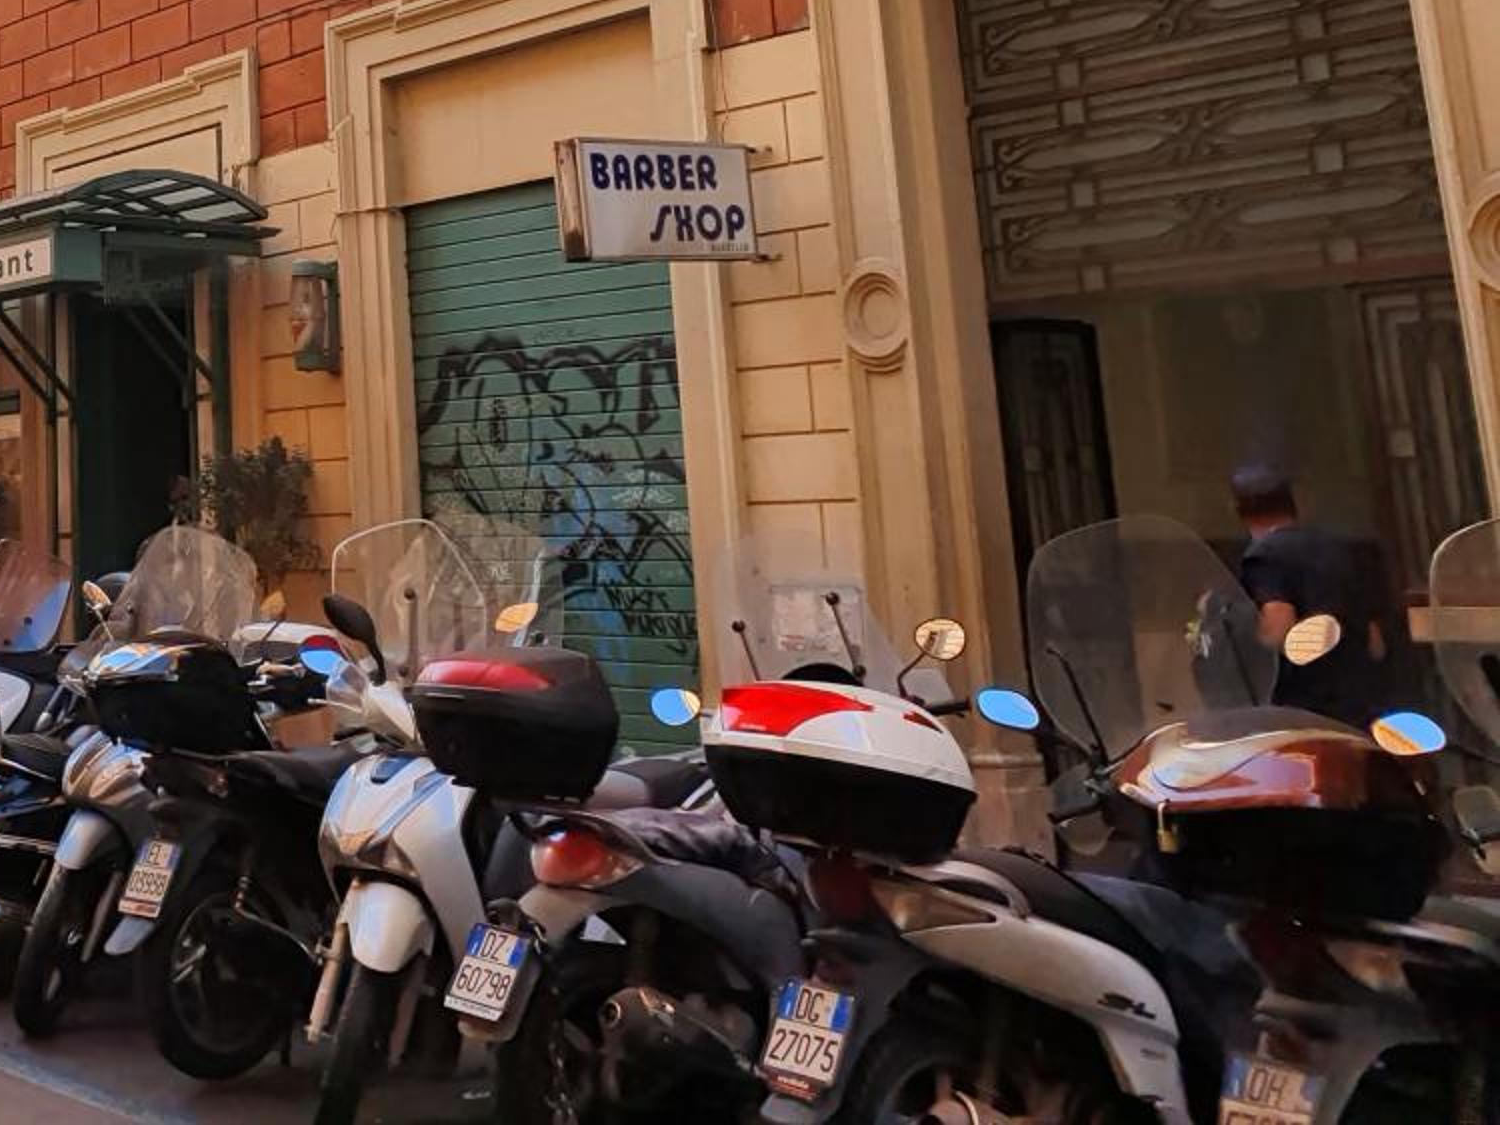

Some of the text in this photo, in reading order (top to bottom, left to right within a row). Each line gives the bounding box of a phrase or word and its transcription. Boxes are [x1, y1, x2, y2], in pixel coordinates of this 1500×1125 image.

[590, 153, 717, 191] BARBER
[650, 205, 745, 242] SHOP
[456, 964, 511, 1001] 60798
[769, 1028, 838, 1073] 27075
